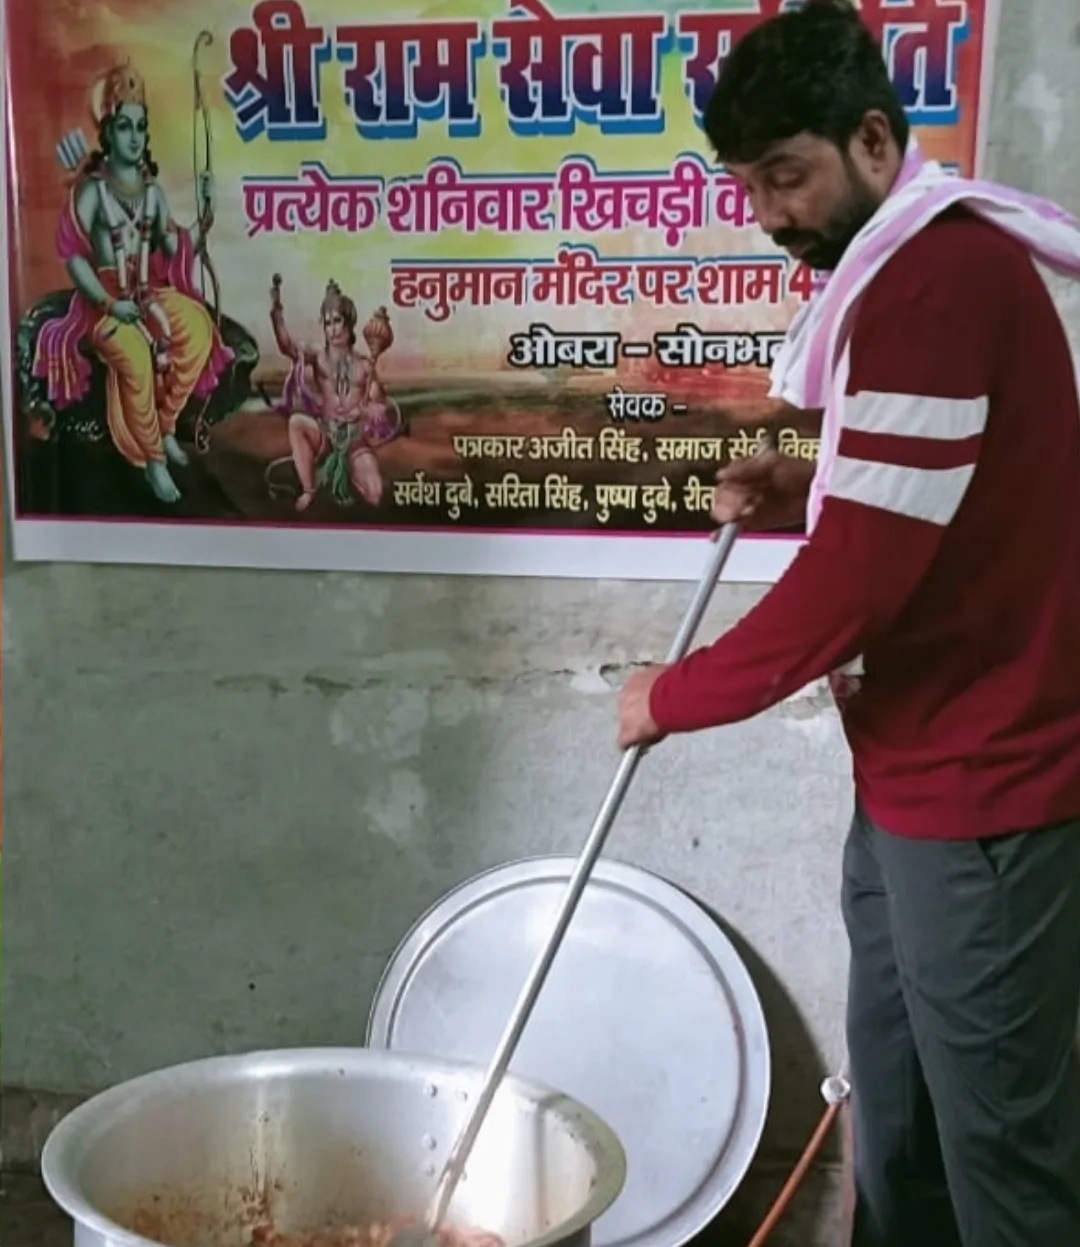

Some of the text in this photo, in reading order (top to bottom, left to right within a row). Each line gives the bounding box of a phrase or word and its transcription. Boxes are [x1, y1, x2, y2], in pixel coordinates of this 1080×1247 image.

[335, 21, 485, 141] राम
[243, 160, 757, 247] प्रत्येक शनिवार खिचड़ी क
[391, 248, 814, 323] हनुमान मंदिर पर शाम 4
[508, 325, 619, 368] ओबरा
[657, 324, 786, 368] सोनभ
[606, 386, 667, 421] सेवक
[453, 434, 527, 460] पत्रकार
[529, 427, 595, 461] अजीत
[599, 427, 649, 463] सिंह,
[656, 436, 722, 462] समाज
[393, 472, 716, 523] सर्वेश दुबे, सरिता सिंह, पुष्पा दुबे, रीत
